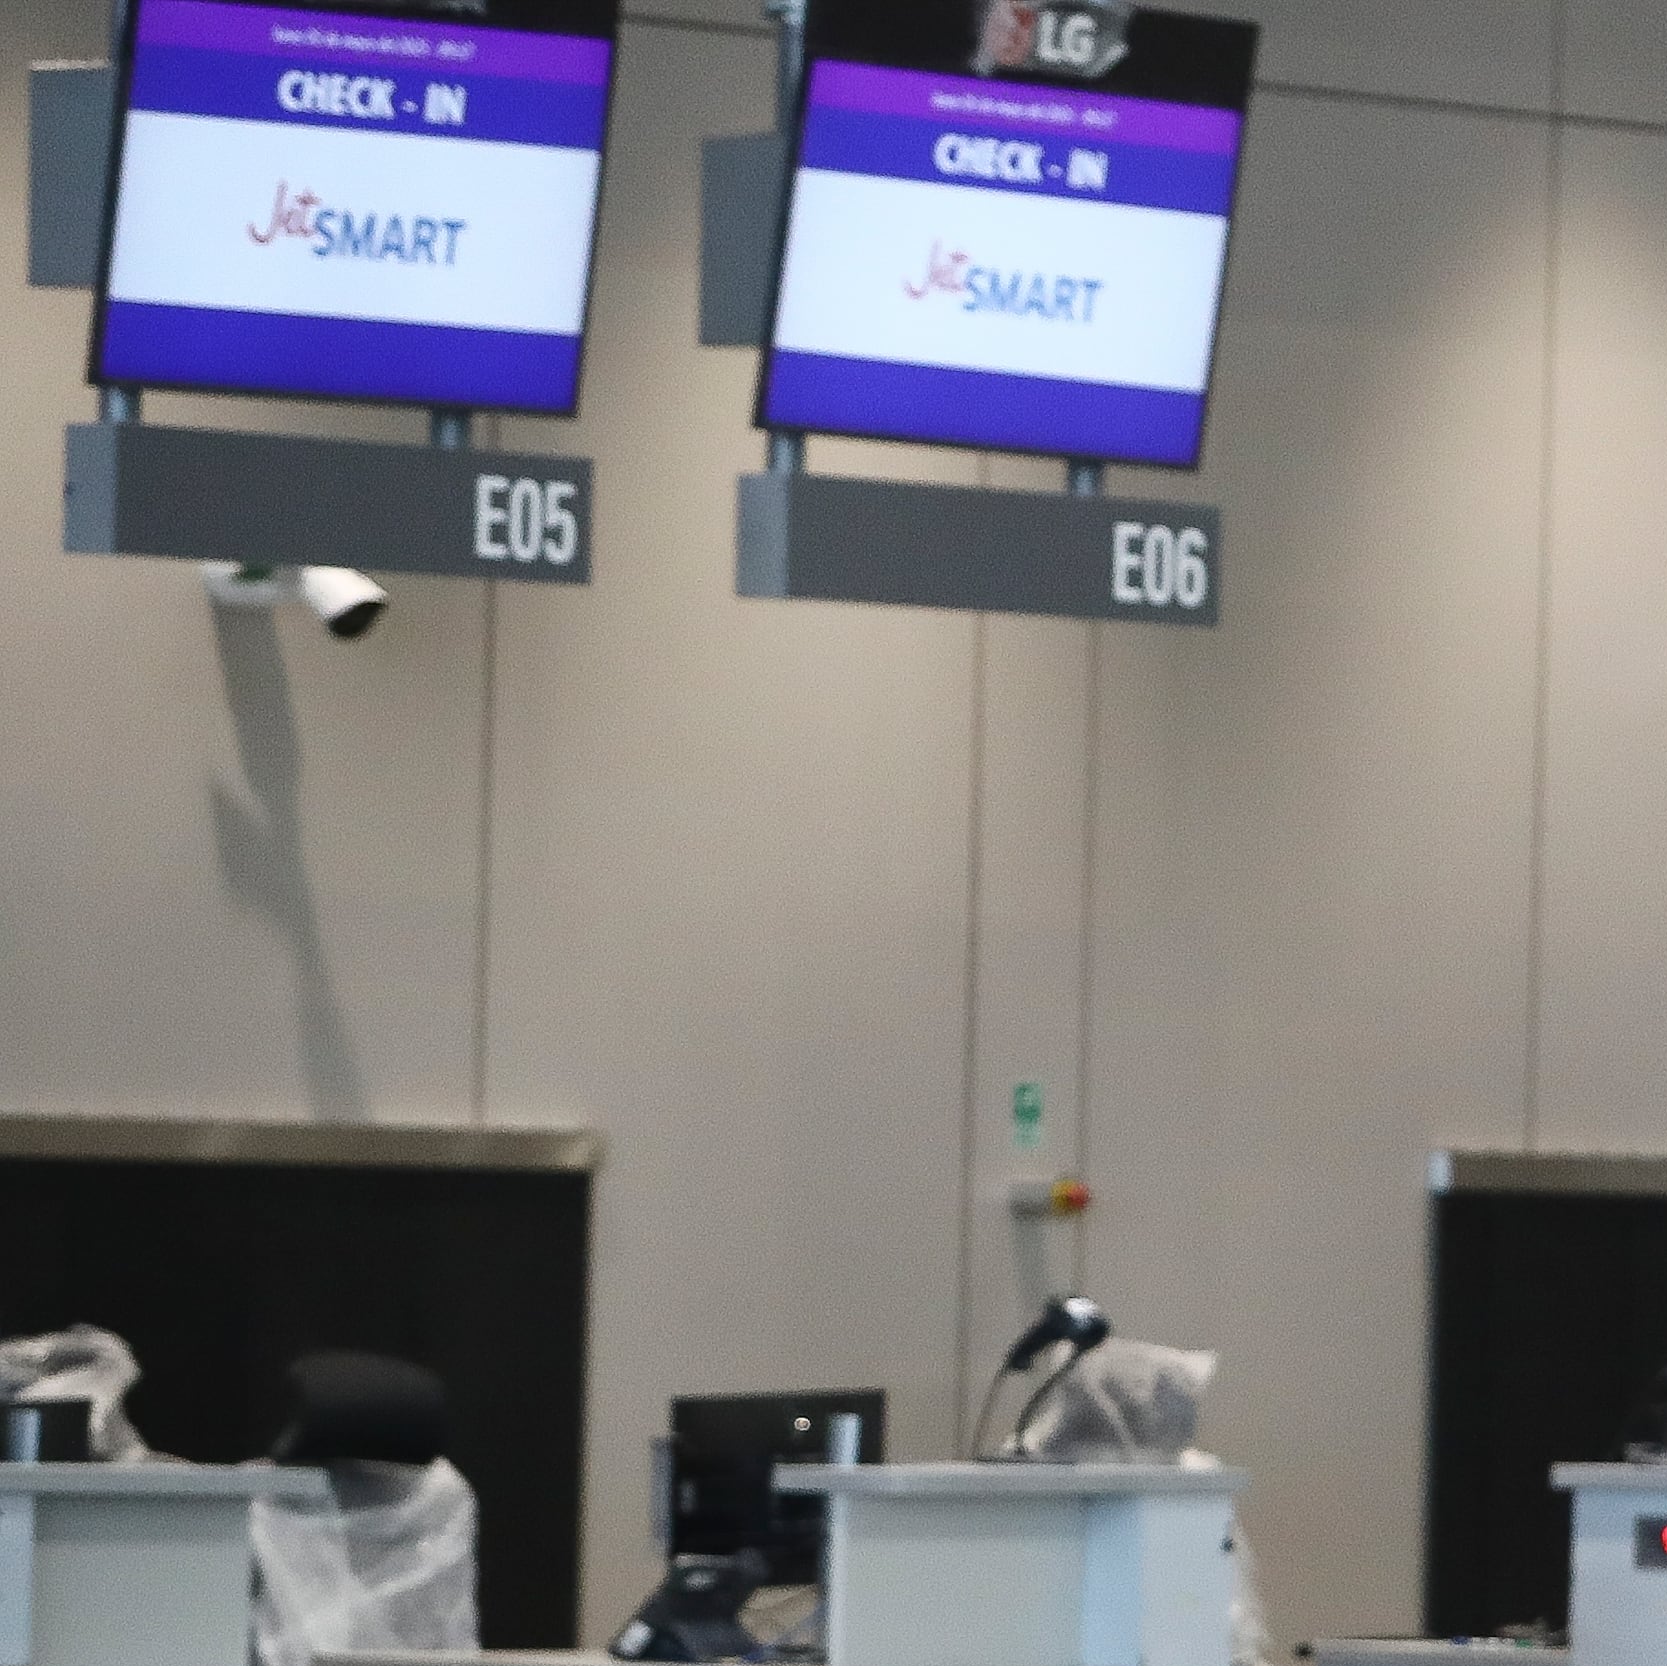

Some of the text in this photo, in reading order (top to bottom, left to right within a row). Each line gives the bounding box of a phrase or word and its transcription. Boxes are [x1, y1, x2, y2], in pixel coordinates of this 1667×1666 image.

[1034, 9, 1098, 65] LG
[277, 69, 396, 121] CHECK
[423, 81, 468, 127] IN
[932, 131, 1045, 185] CHECK
[1065, 145, 1110, 193] IN
[472, 473, 578, 565] E05
[1111, 521, 1209, 609] E06
